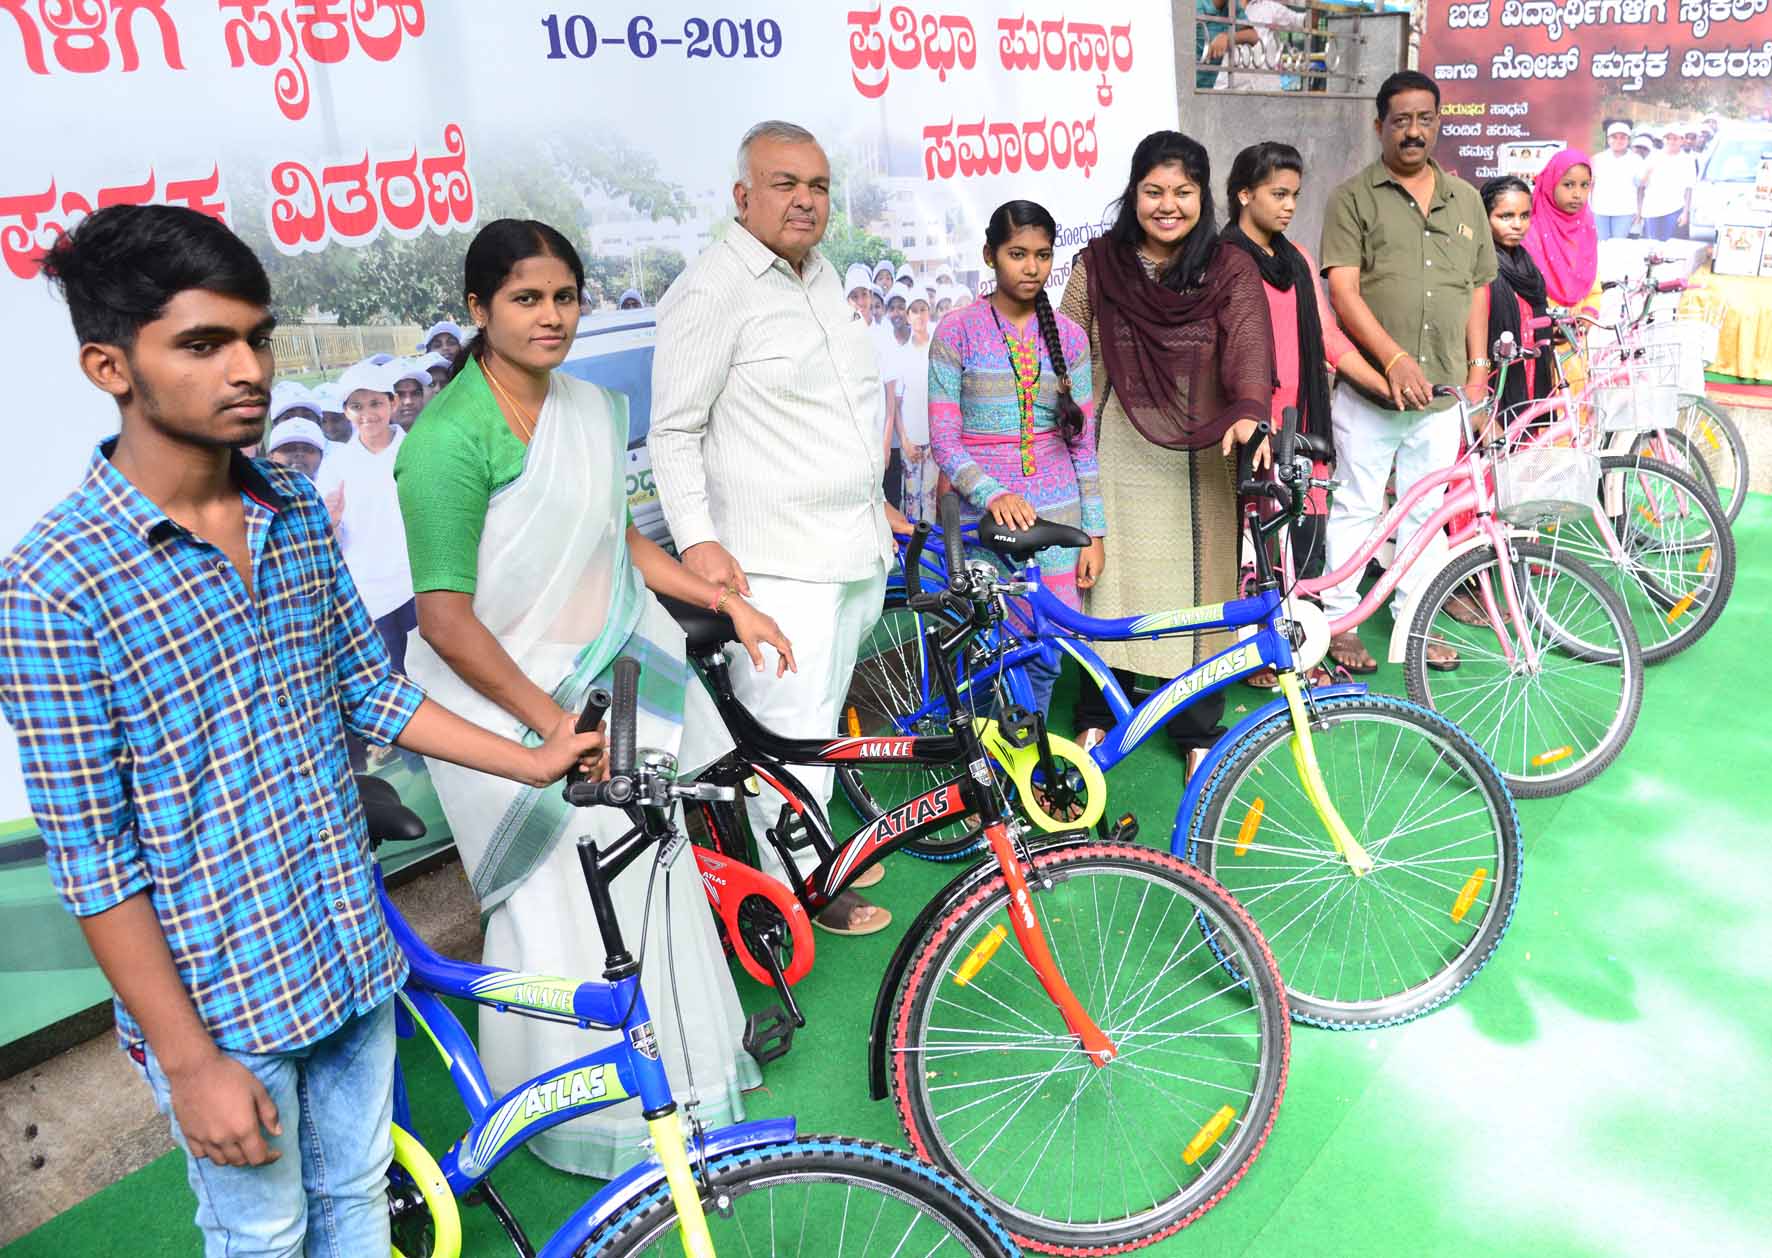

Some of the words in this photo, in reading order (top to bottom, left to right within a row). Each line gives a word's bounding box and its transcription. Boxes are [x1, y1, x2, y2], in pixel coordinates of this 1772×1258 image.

[541, 13, 783, 60] 10-6-2019
[1448, 1, 1489, 28] ಬಡ
[847, 3, 977, 99] ಪ್ರತಿಭಾ
[998, 12, 1133, 107] ಪುರಸ್ಕಾರ
[1434, 63, 1478, 80] ಹಾಗೂ
[1491, 45, 1580, 79] ನೋಟ್
[1591, 47, 1669, 91] ಪುಸ್ತಕ
[1681, 41, 1772, 78] ವಿತರಣೆ
[1489, 102, 1528, 117] ಸಾಧನೆ
[923, 113, 1098, 181] ಸಮಾರಂಭ
[271, 123, 474, 246] ವಿತರಣೆ
[1172, 647, 1248, 703] ATLAS
[859, 741, 912, 757] AMAZE
[875, 787, 949, 844] ATLAS
[702, 871, 727, 886] ATLAS
[514, 983, 572, 1012] AMAZE
[524, 1064, 606, 1120] ATLAS
